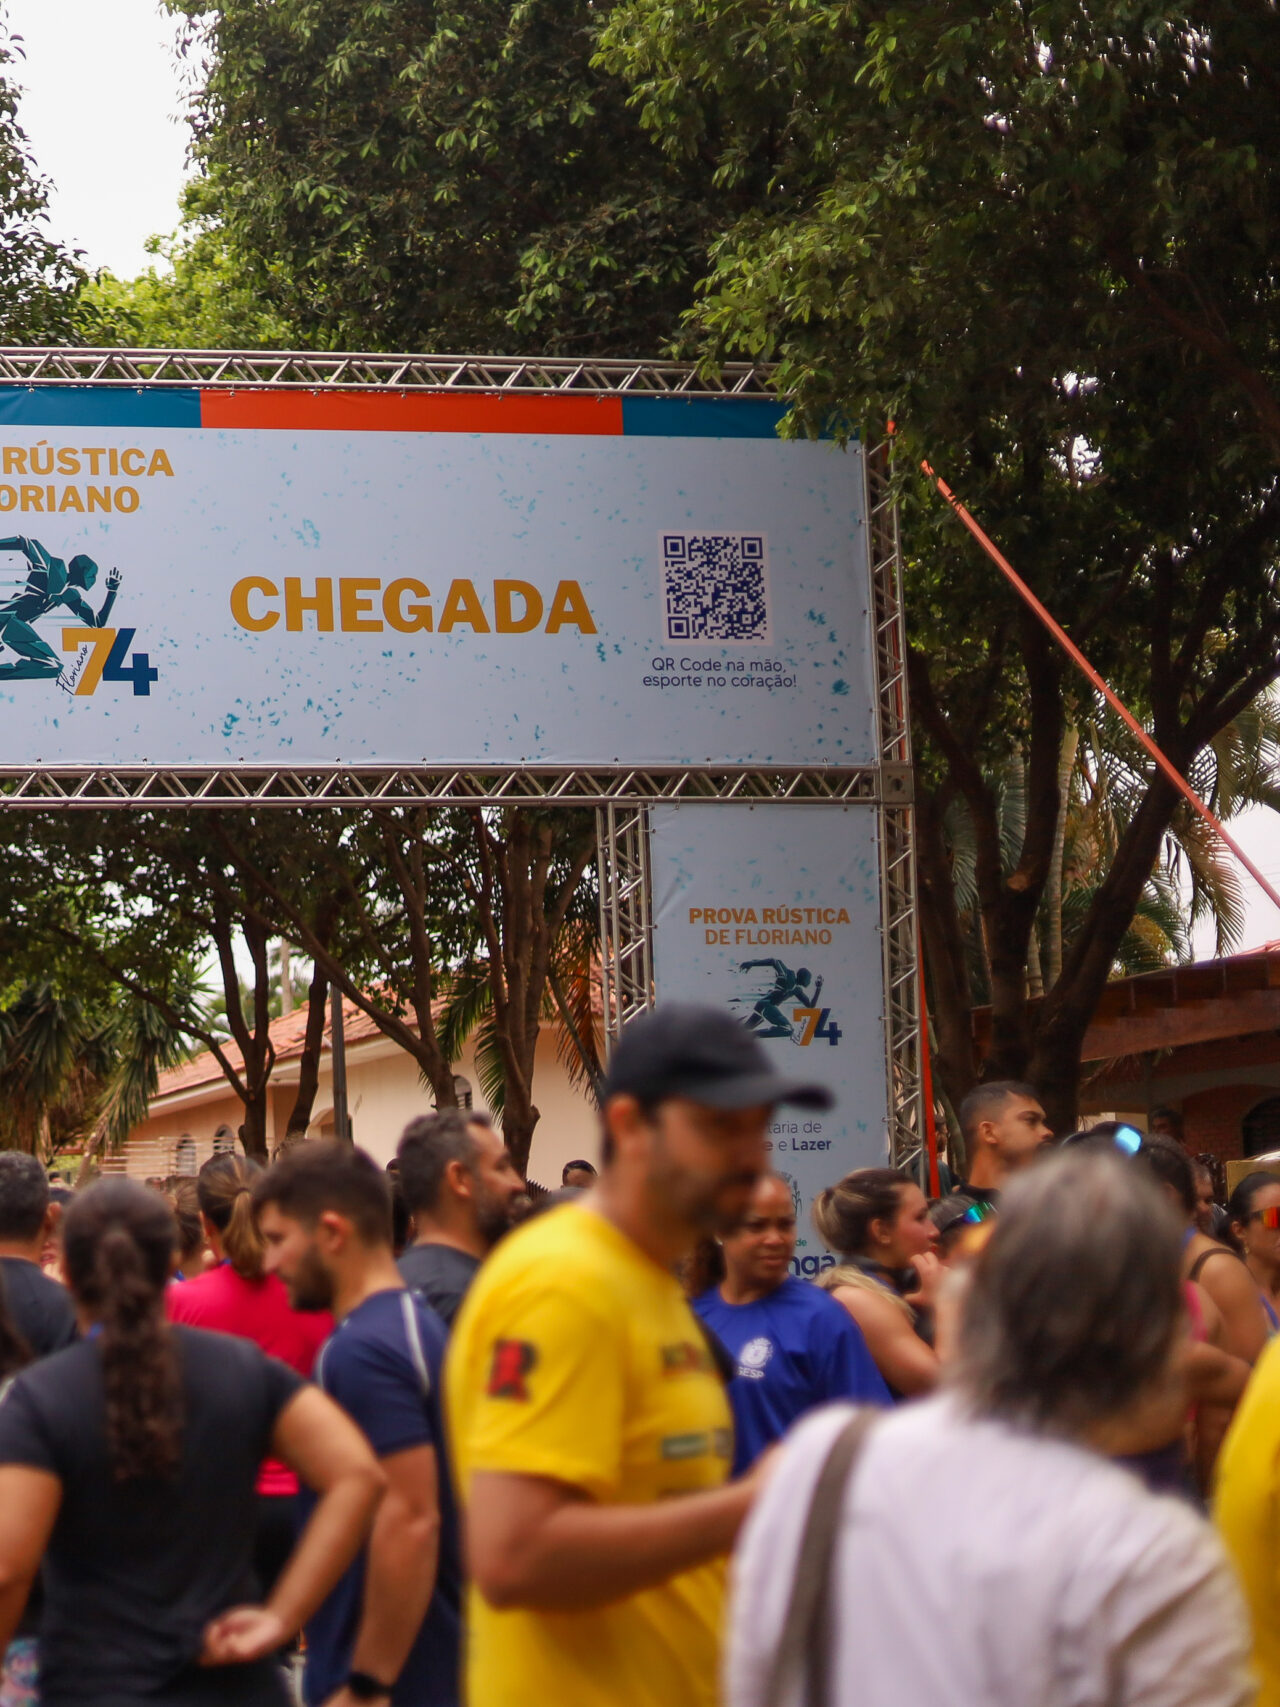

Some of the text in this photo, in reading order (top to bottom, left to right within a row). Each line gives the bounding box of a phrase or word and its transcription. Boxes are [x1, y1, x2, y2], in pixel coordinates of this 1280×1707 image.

[2, 440, 174, 476] RÚSTICA
[230, 576, 598, 634] CHEGADA
[55, 644, 89, 696] Floriano
[62, 628, 158, 696] 74
[652, 657, 786, 673] QR Code na mão,
[643, 674, 797, 691] esporte no coração!
[689, 904, 851, 924] PROVA RÚSTICA
[705, 929, 832, 945] DE FLORIANO
[793, 1007, 842, 1046] 74
[803, 1120, 822, 1134] de
[778, 1140, 787, 1151] e
[792, 1138, 832, 1151] Lazer
[795, 1238, 807, 1247] de
